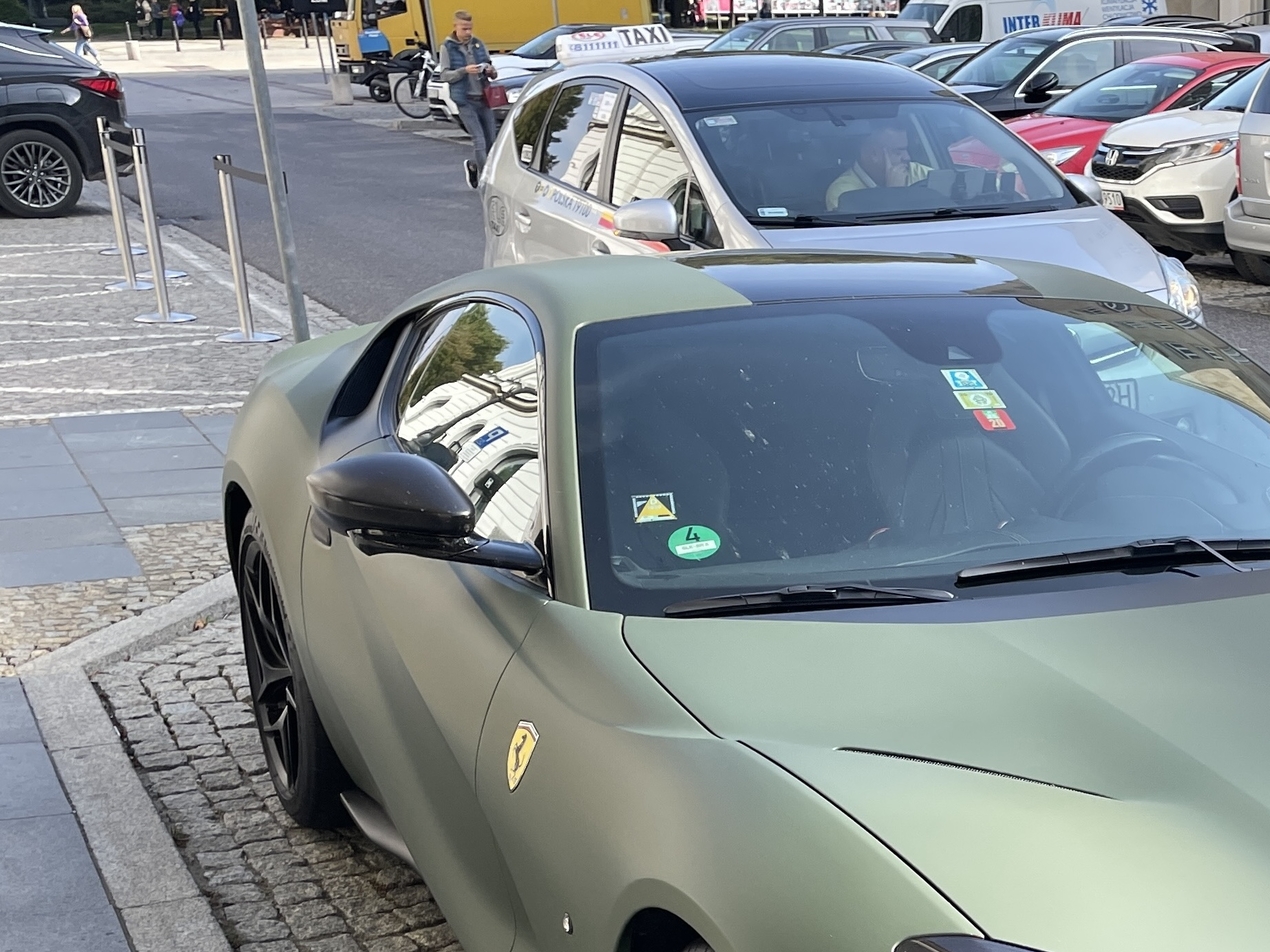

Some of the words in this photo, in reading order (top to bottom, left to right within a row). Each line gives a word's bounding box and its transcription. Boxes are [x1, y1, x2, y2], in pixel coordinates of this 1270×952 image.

[1003, 15, 1040, 34] INTER
[618, 26, 669, 46] TAXI
[685, 527, 701, 542] 4
